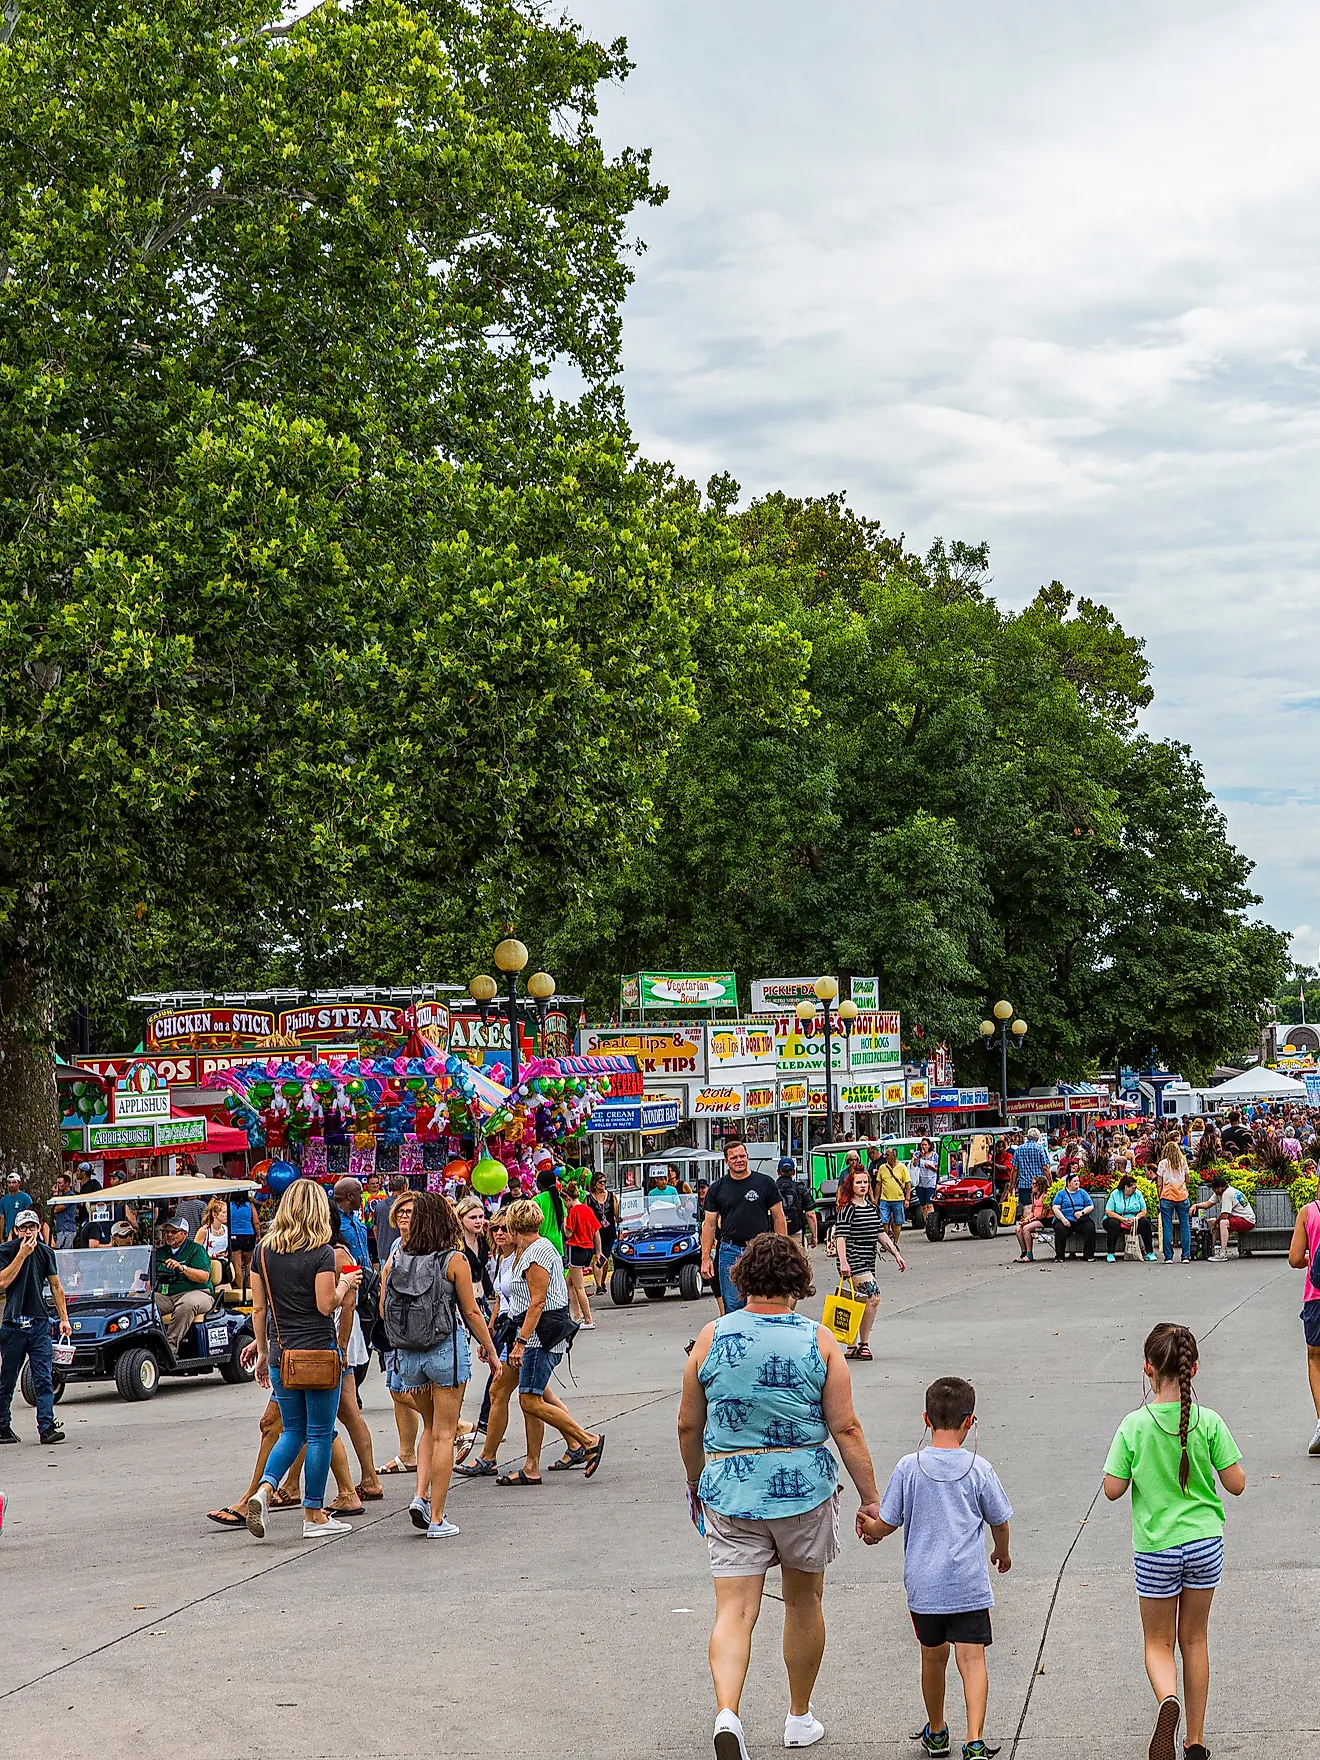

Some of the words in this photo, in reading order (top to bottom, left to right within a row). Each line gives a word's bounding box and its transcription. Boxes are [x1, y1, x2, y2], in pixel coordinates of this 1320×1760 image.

[666, 980, 709, 994] Vegetarian
[763, 985, 797, 996] PICKLE
[801, 984, 815, 995] DA
[680, 993, 700, 1005] Bowl
[148, 1009, 173, 1024] CAJUN
[285, 1011, 315, 1033] Philly
[317, 1008, 397, 1030] STEAK
[155, 1013, 212, 1039] CHICKEN
[213, 1021, 223, 1032] on
[224, 1021, 230, 1032] a
[232, 1013, 271, 1035] STICK
[851, 1015, 872, 1036] FOOT
[874, 1014, 898, 1034] LONGS
[588, 1036, 630, 1051] Steak
[636, 1035, 667, 1053] Tips
[672, 1033, 685, 1047] &
[711, 1037, 726, 1054] Steak
[727, 1037, 738, 1058] Tips
[746, 1036, 761, 1053] PORK
[762, 1035, 773, 1052] TIPS
[860, 1037, 872, 1049] HOT
[874, 1036, 889, 1048] DOGS
[662, 1056, 696, 1073] TIPS
[702, 1087, 734, 1098] Cold
[746, 1091, 761, 1106] PORK
[762, 1090, 774, 1104] TIPS
[780, 1088, 795, 1102] Steak
[796, 1086, 806, 1100] Tips
[841, 1085, 880, 1096] PICKLE
[118, 1096, 168, 1114] APPLISHUS
[847, 1094, 874, 1103] DAWG
[1035, 1100, 1064, 1111] Smoothies
[606, 1110, 634, 1118] CREAM
[695, 1100, 741, 1113] Drinks
[642, 1109, 665, 1124] WONDER
[665, 1107, 677, 1122] BAR
[94, 1131, 122, 1145] APPLE
[122, 1129, 150, 1143] SLUSH
